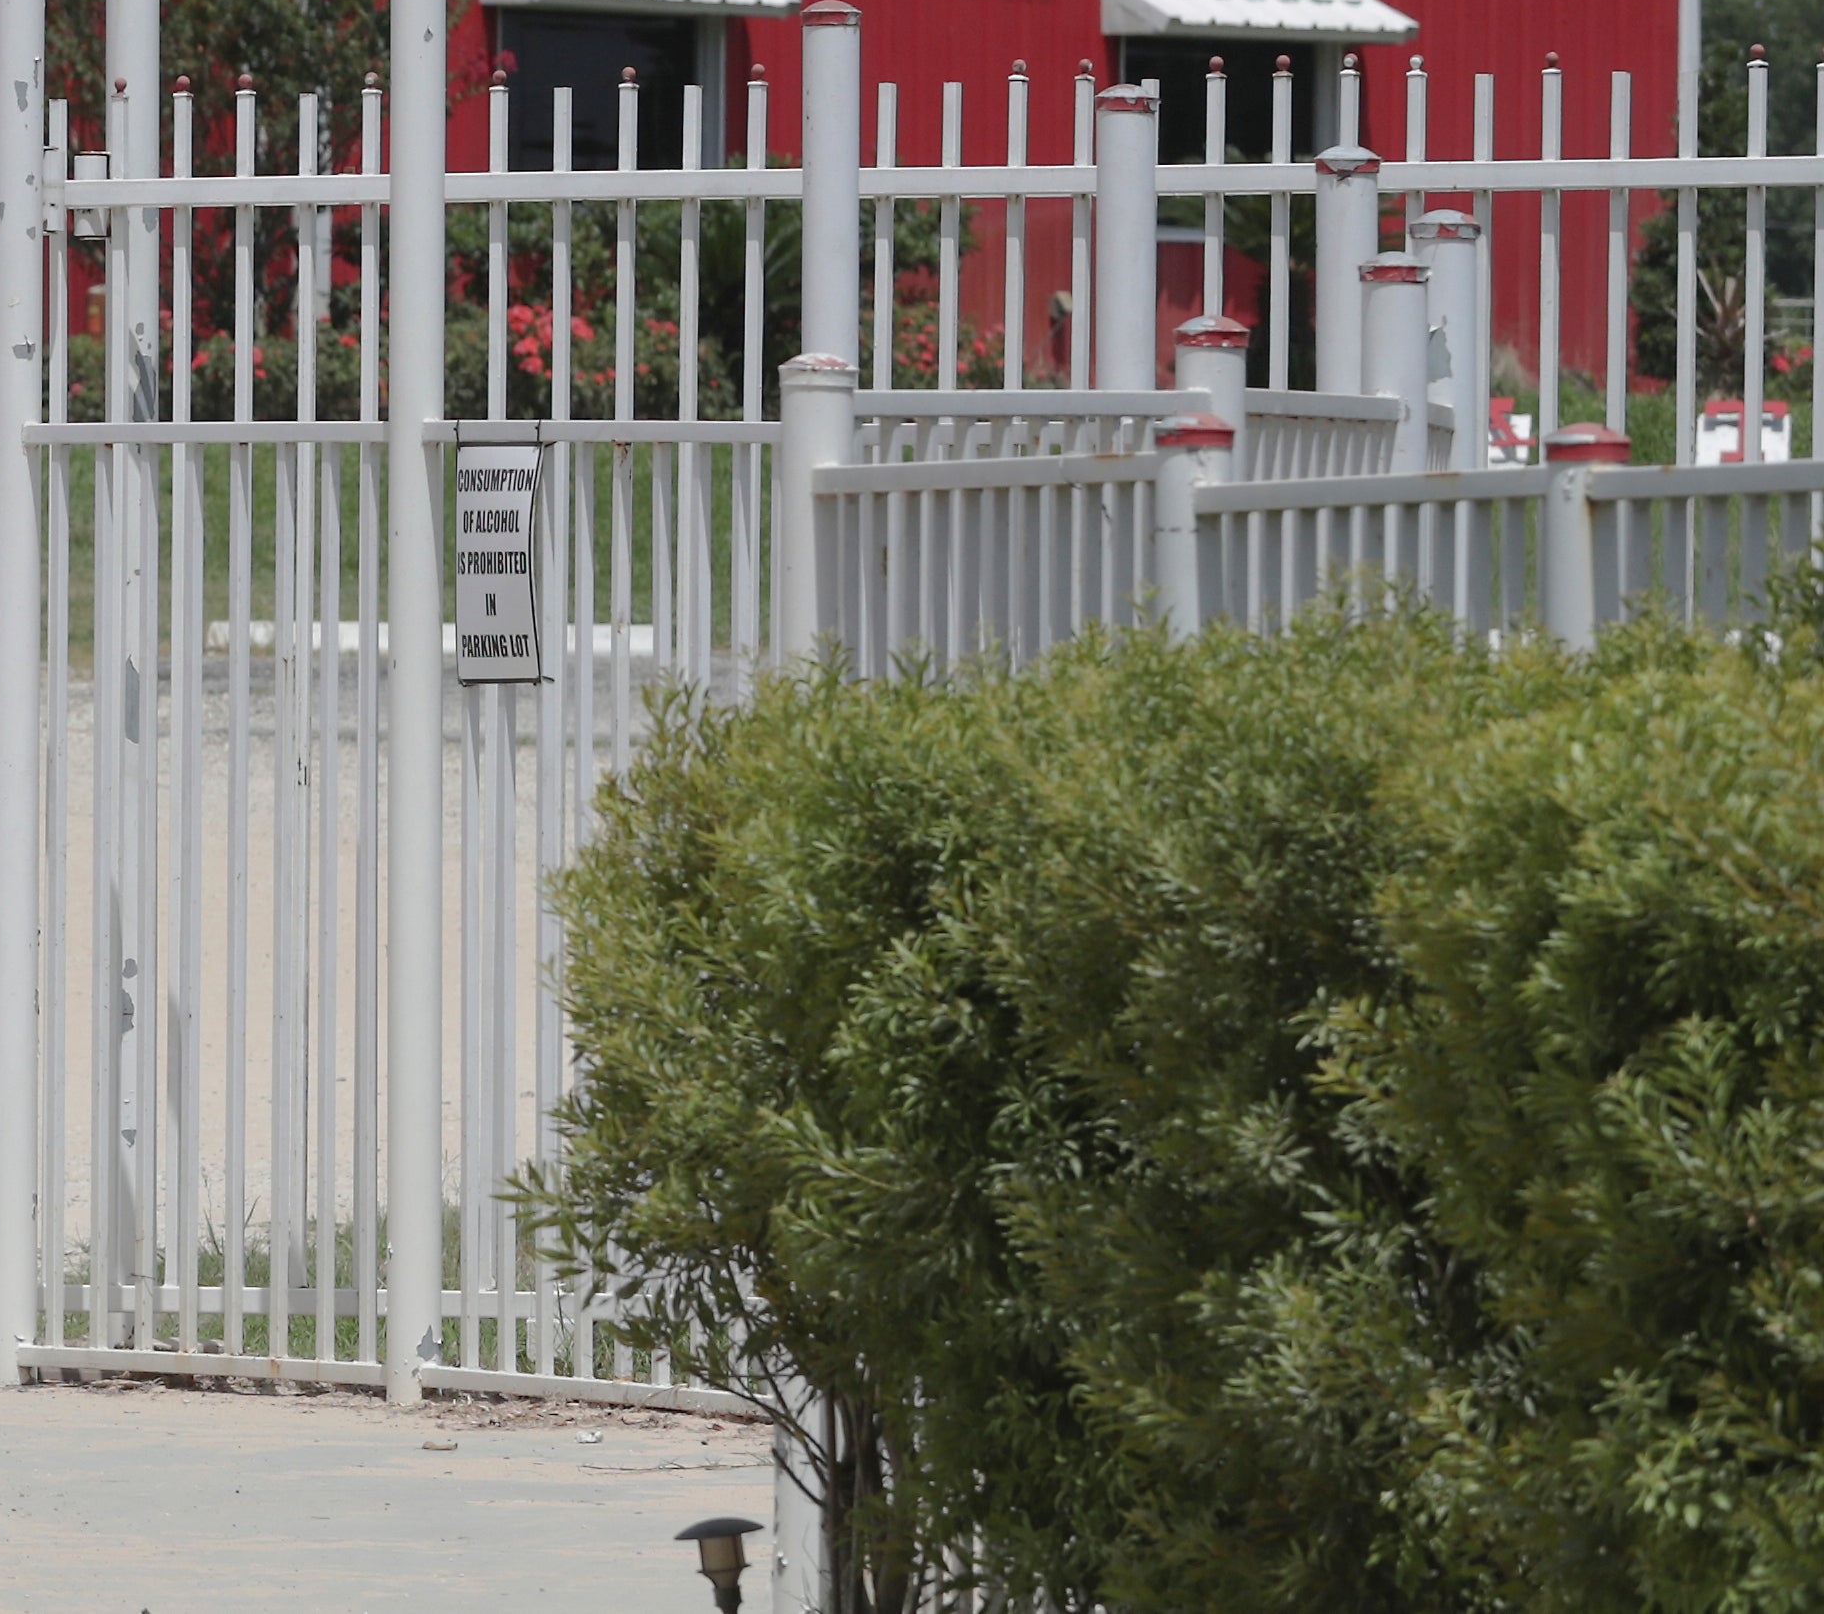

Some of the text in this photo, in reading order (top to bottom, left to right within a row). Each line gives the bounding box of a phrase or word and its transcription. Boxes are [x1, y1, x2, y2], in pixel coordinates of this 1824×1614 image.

[457, 468, 534, 493] CONSUMPTION
[463, 509, 520, 534] OF ALCOHOL
[457, 551, 527, 575] IS PROHIBITED
[485, 592, 497, 617] IN
[461, 634, 530, 659] PARKING LOT
